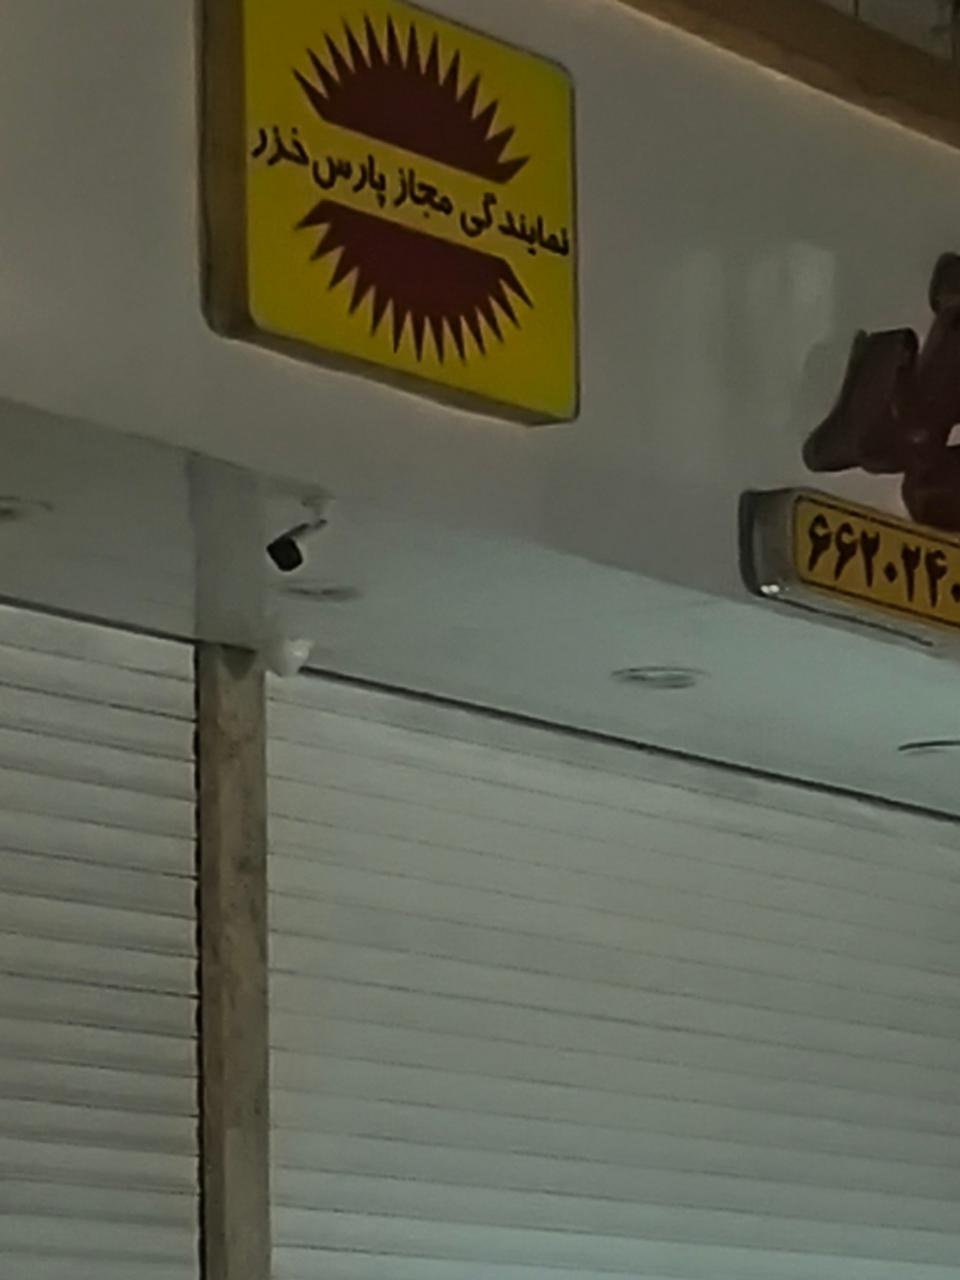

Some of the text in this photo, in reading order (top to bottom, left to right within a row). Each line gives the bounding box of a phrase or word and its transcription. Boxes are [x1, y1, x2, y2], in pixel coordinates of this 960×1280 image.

[251, 125, 571, 256] نمایندگی مجاز پارس خزر
